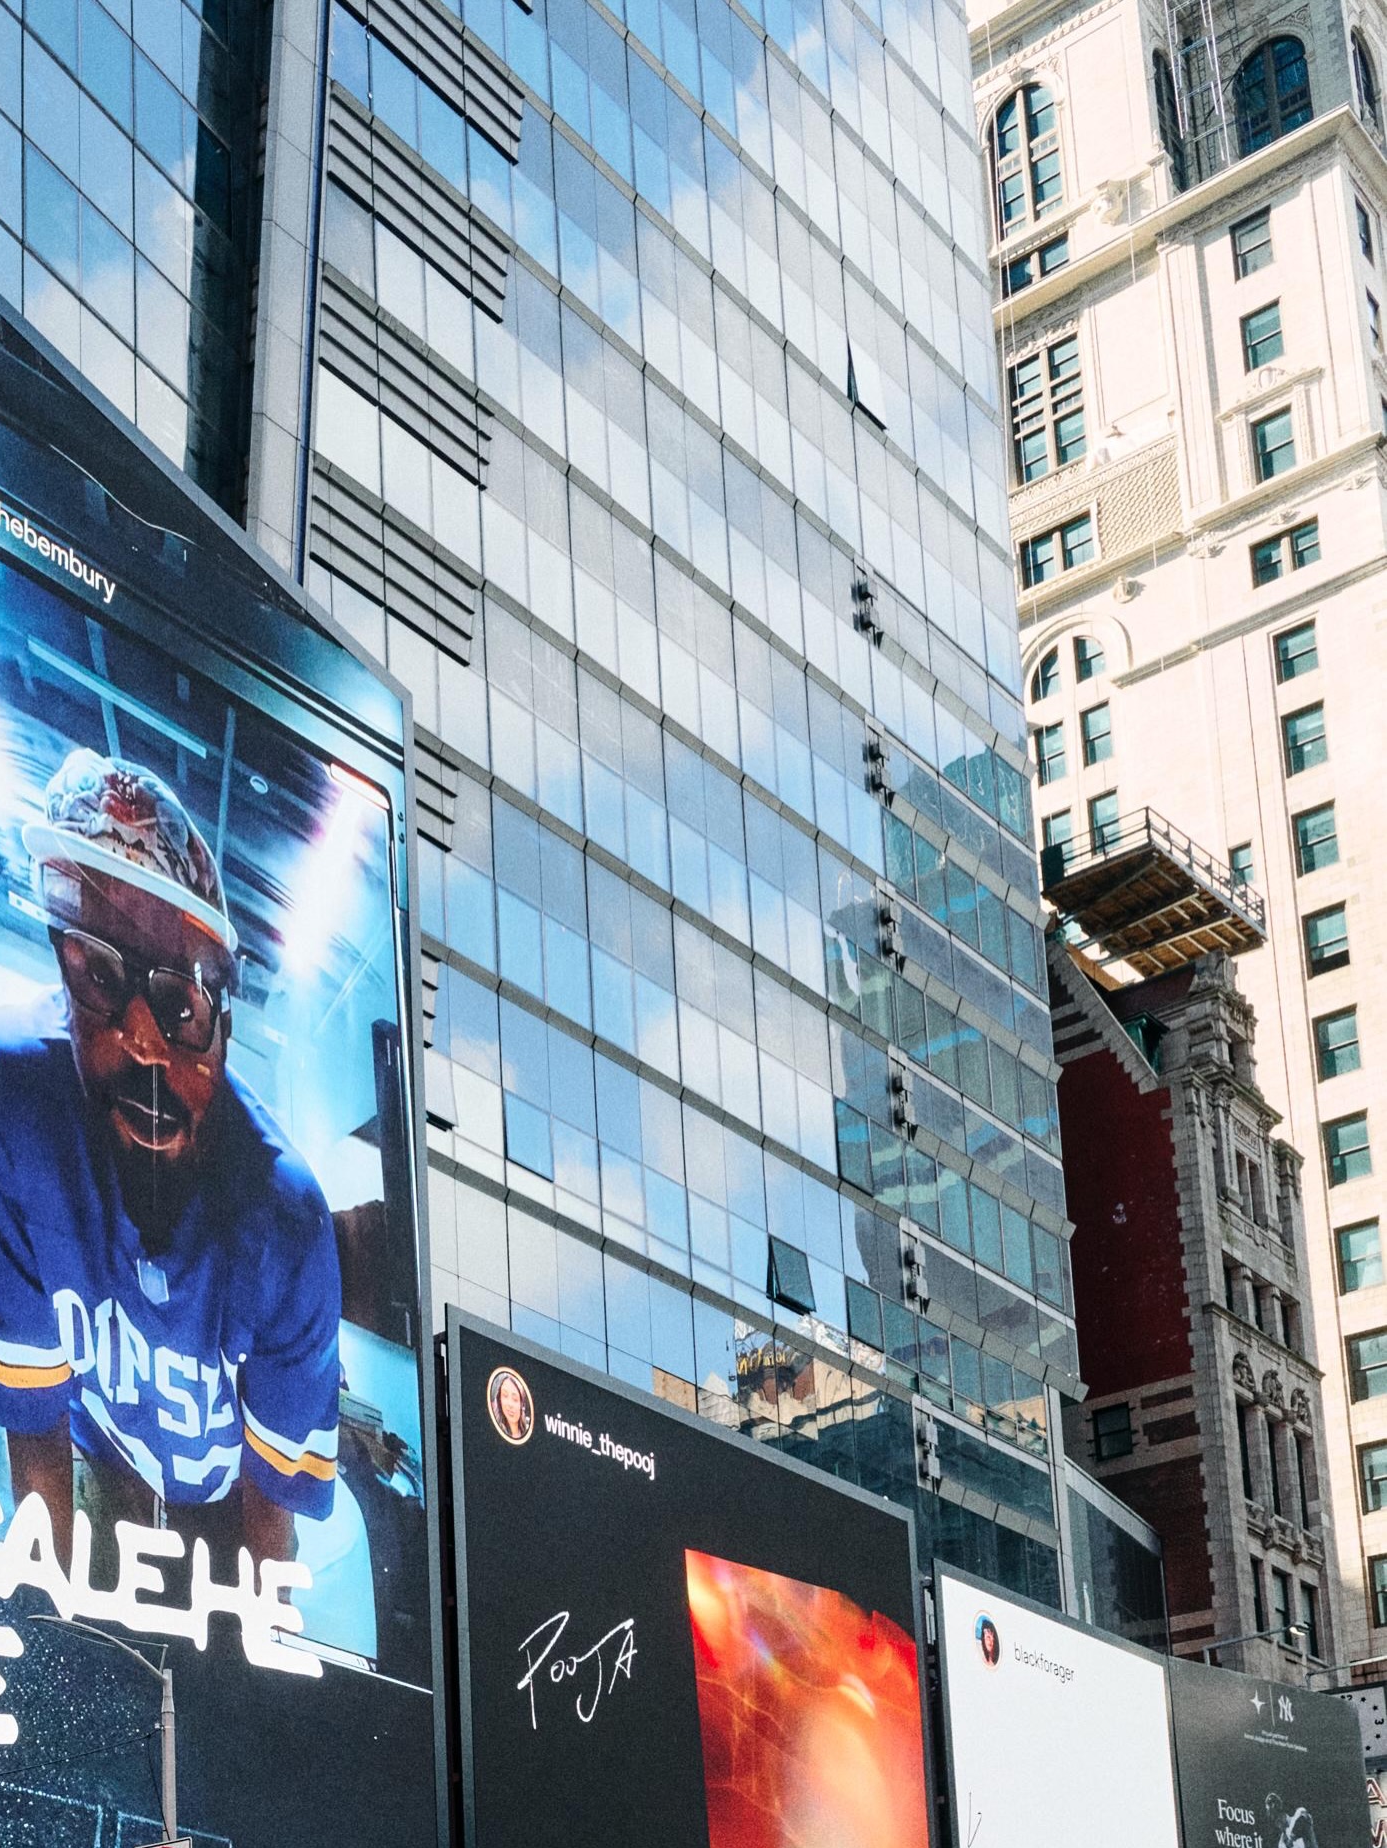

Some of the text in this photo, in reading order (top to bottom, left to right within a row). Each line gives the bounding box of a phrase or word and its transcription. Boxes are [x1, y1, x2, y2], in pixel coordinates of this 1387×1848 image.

[544, 1413, 655, 1481] winnie_thepooj
[1014, 1641, 1074, 1684] blackforager
[1217, 1798, 1255, 1825] Focus
[1215, 1827, 1253, 1848] where
